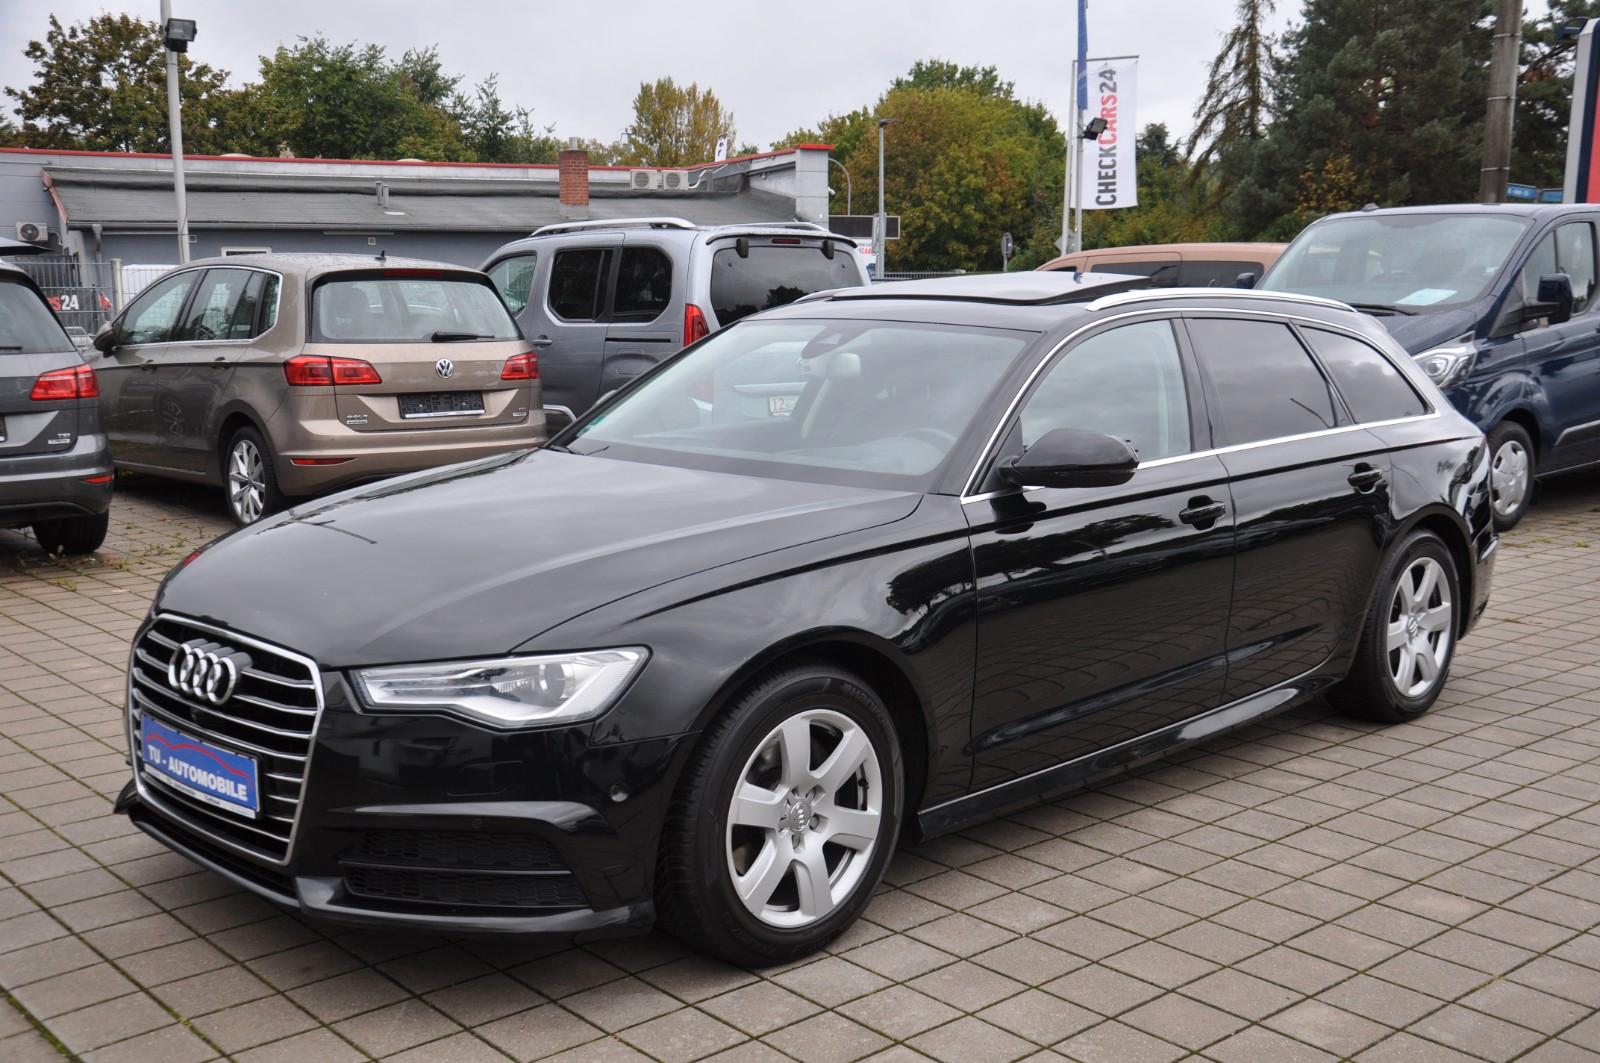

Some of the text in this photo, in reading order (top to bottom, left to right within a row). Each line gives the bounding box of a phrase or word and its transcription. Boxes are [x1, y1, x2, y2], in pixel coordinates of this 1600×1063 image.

[47, 294, 80, 312] S24
[148, 745, 161, 764] TU
[168, 757, 248, 801] AUTOMOBILE
